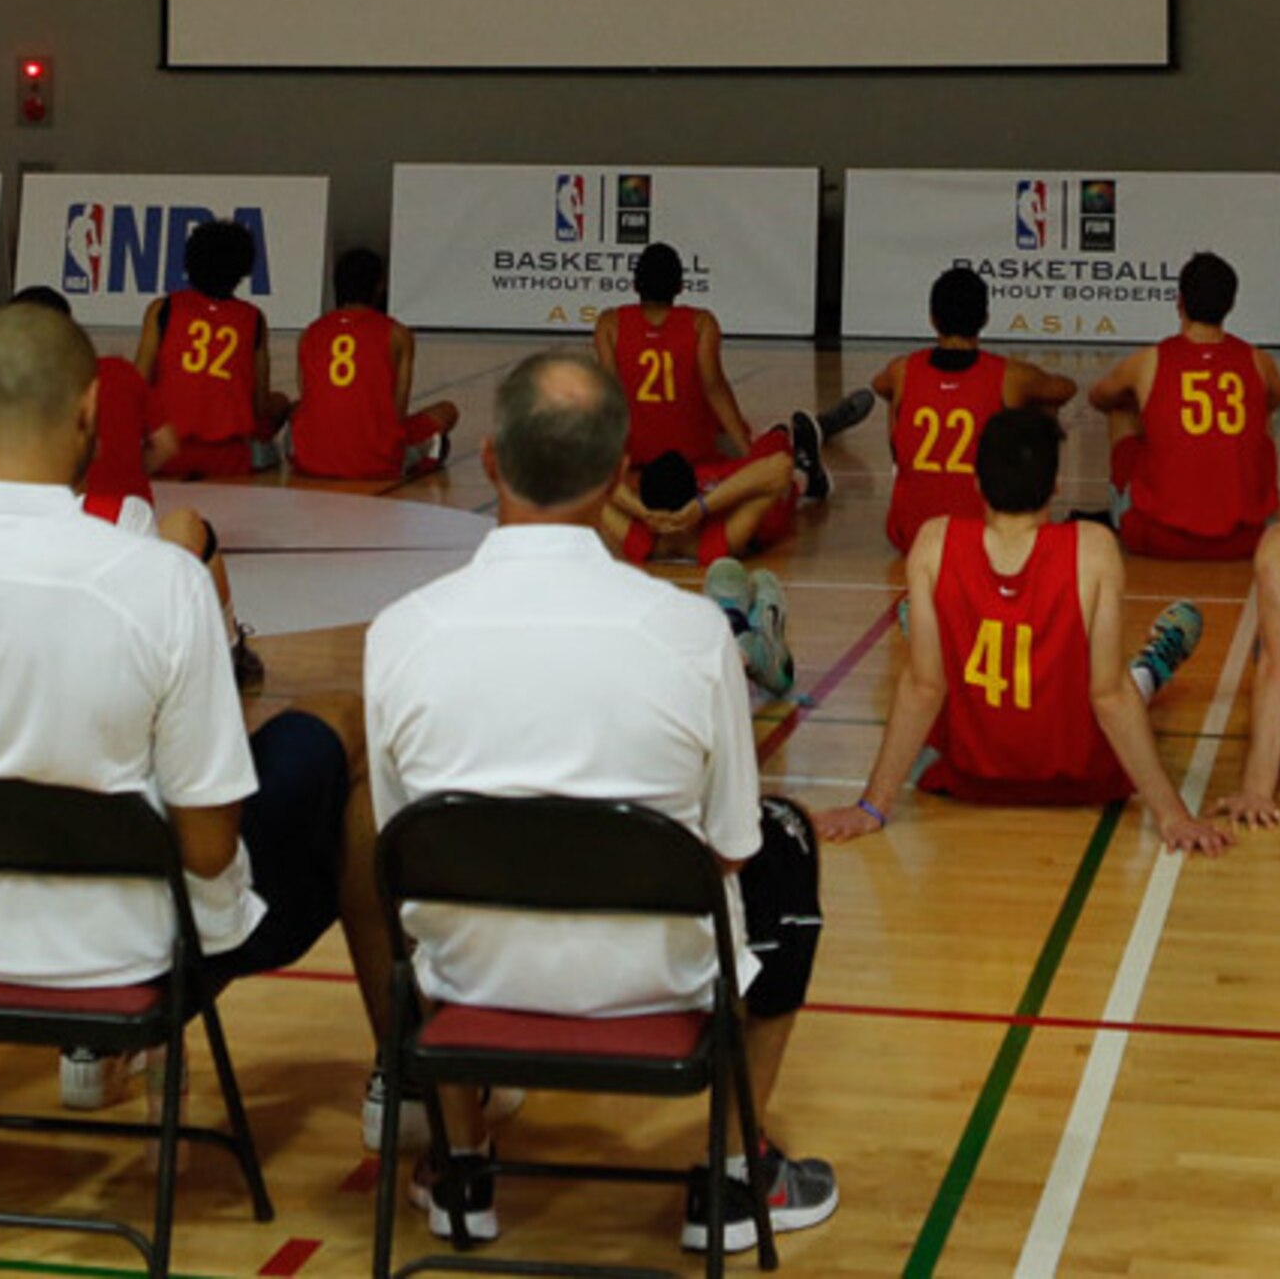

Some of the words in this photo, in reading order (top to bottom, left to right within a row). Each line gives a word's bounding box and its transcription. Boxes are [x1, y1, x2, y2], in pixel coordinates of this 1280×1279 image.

[492, 276, 593, 291] WITHOUT
[599, 277, 710, 292] BORS
[494, 252, 709, 273] BASKETBL
[548, 305, 597, 322] AS
[991, 285, 1056, 300] HOUT
[1063, 285, 1177, 302] BORDERS
[180, 319, 240, 382] 32
[1009, 313, 1115, 333] ASIA
[328, 331, 357, 387] 8
[635, 348, 676, 404] 21
[1179, 370, 1247, 437] 53
[912, 405, 976, 475] 22
[963, 619, 1034, 711] 41
